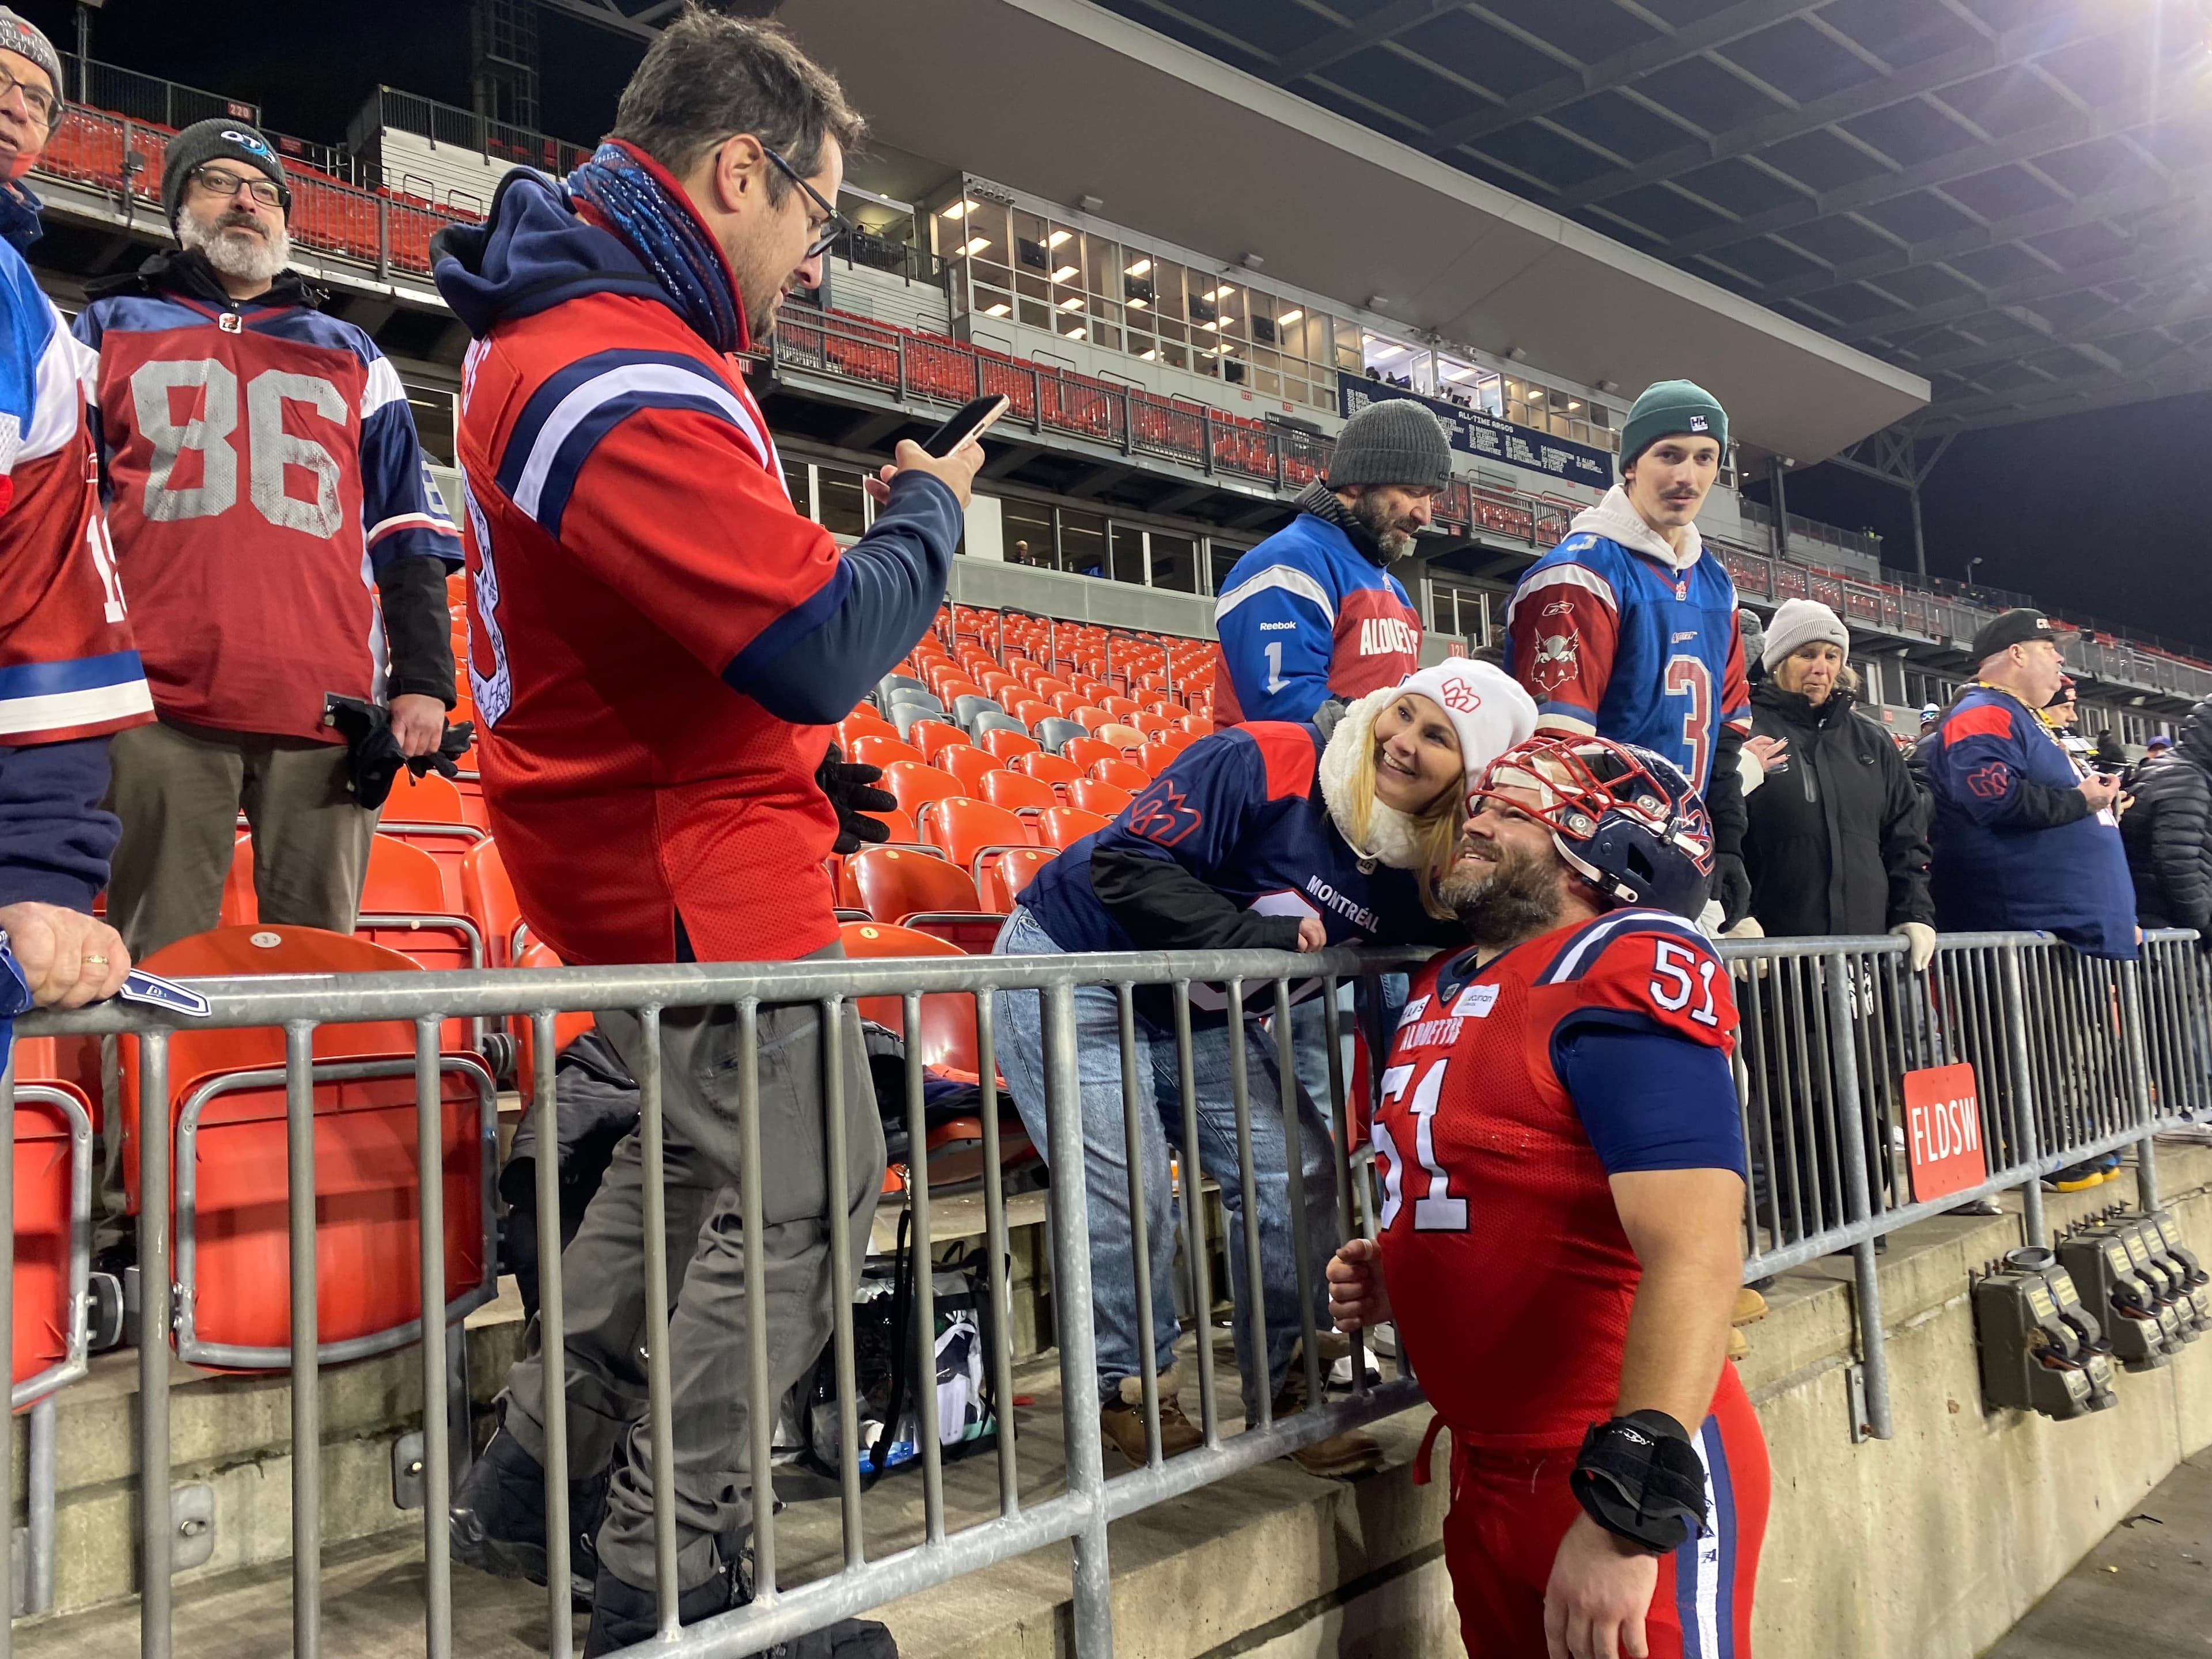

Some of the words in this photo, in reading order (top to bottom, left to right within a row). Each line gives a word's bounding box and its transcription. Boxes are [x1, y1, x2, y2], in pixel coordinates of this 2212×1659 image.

[230, 104, 249, 118] 220
[130, 358, 348, 539] 86
[1458, 411, 1491, 426] ALL-TIME
[1492, 421, 1514, 433] ARGOS
[1582, 457, 1596, 466] ALLEN
[1260, 621, 1297, 631] Reebok
[1450, 643, 1464, 657] 121
[1264, 641, 1291, 696] 1
[1664, 654, 1712, 795] 3
[1306, 874, 1379, 934] MONTRÉAL
[1650, 940, 1719, 1027] 51
[1370, 1058, 1468, 1231] 51
[1911, 1096, 1978, 1166] FLDSW
